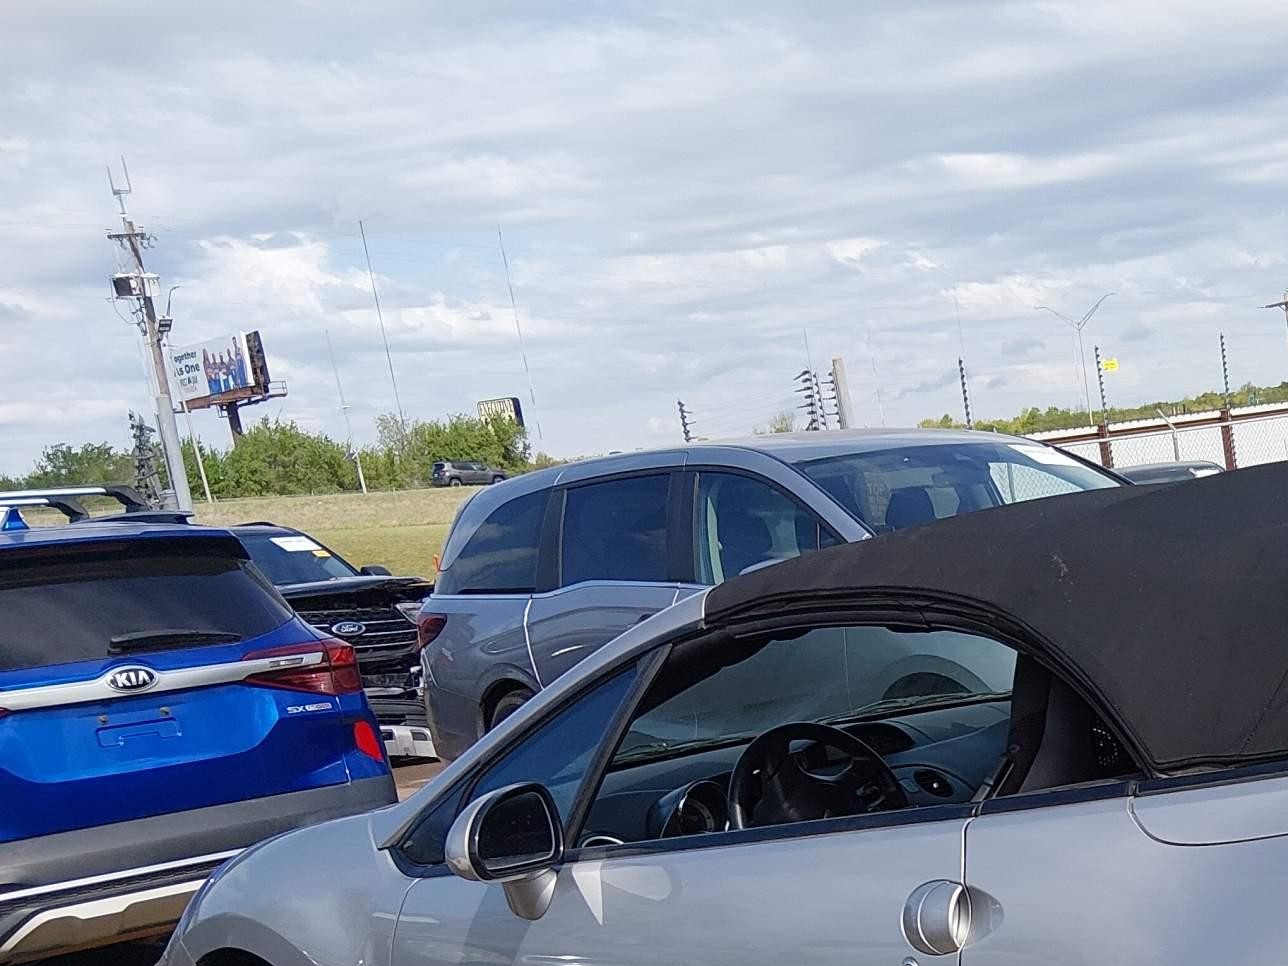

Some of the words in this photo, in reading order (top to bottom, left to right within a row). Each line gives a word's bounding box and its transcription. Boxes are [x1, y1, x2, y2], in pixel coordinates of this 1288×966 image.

[184, 363, 201, 374] One
[114, 670, 151, 688] KIA
[286, 705, 305, 714] SX
